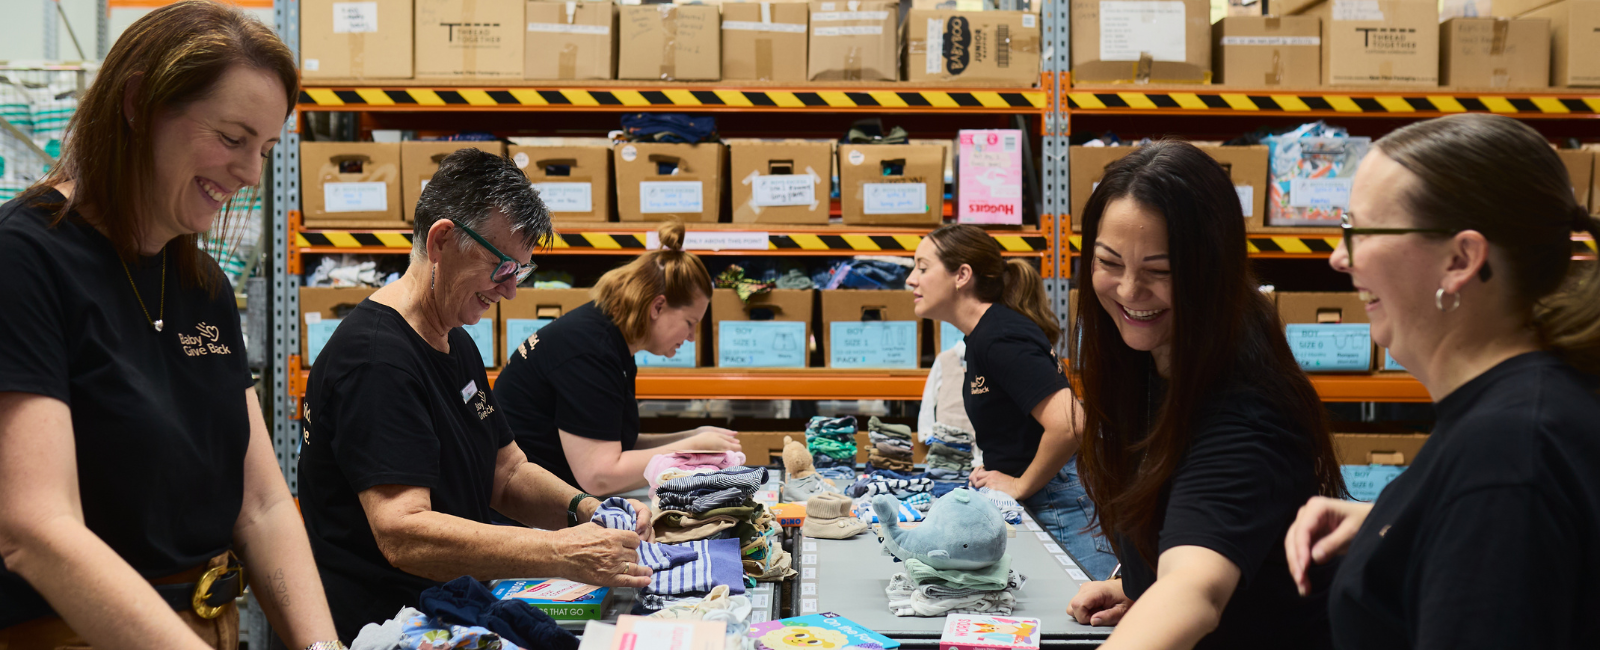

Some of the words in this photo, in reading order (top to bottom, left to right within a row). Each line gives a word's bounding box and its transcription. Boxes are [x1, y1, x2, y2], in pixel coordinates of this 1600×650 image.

[969, 203, 1014, 215] HUGGIES
[178, 333, 202, 346] Baby
[1299, 341, 1315, 349] SIZE
[183, 345, 207, 356] Give
[206, 343, 231, 355] Back
[550, 608, 568, 616] THAT
[570, 608, 584, 616] GO
[823, 618, 841, 627] On
[838, 625, 858, 635] the
